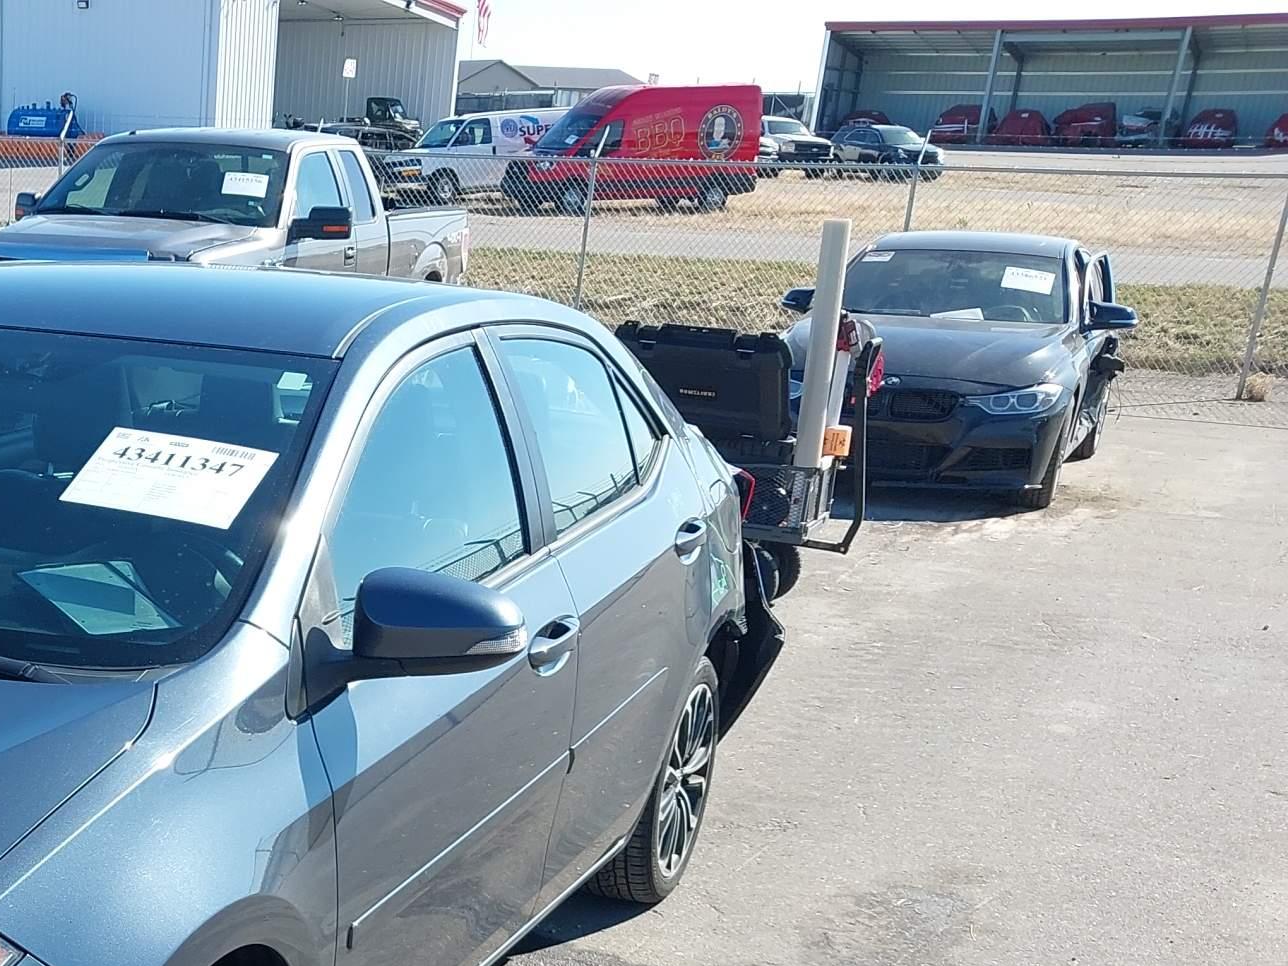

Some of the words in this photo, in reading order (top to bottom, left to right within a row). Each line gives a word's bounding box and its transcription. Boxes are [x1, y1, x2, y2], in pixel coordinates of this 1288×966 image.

[518, 123, 555, 137] SUPE
[634, 114, 686, 153] BBQ
[113, 446, 245, 477] 43411347
